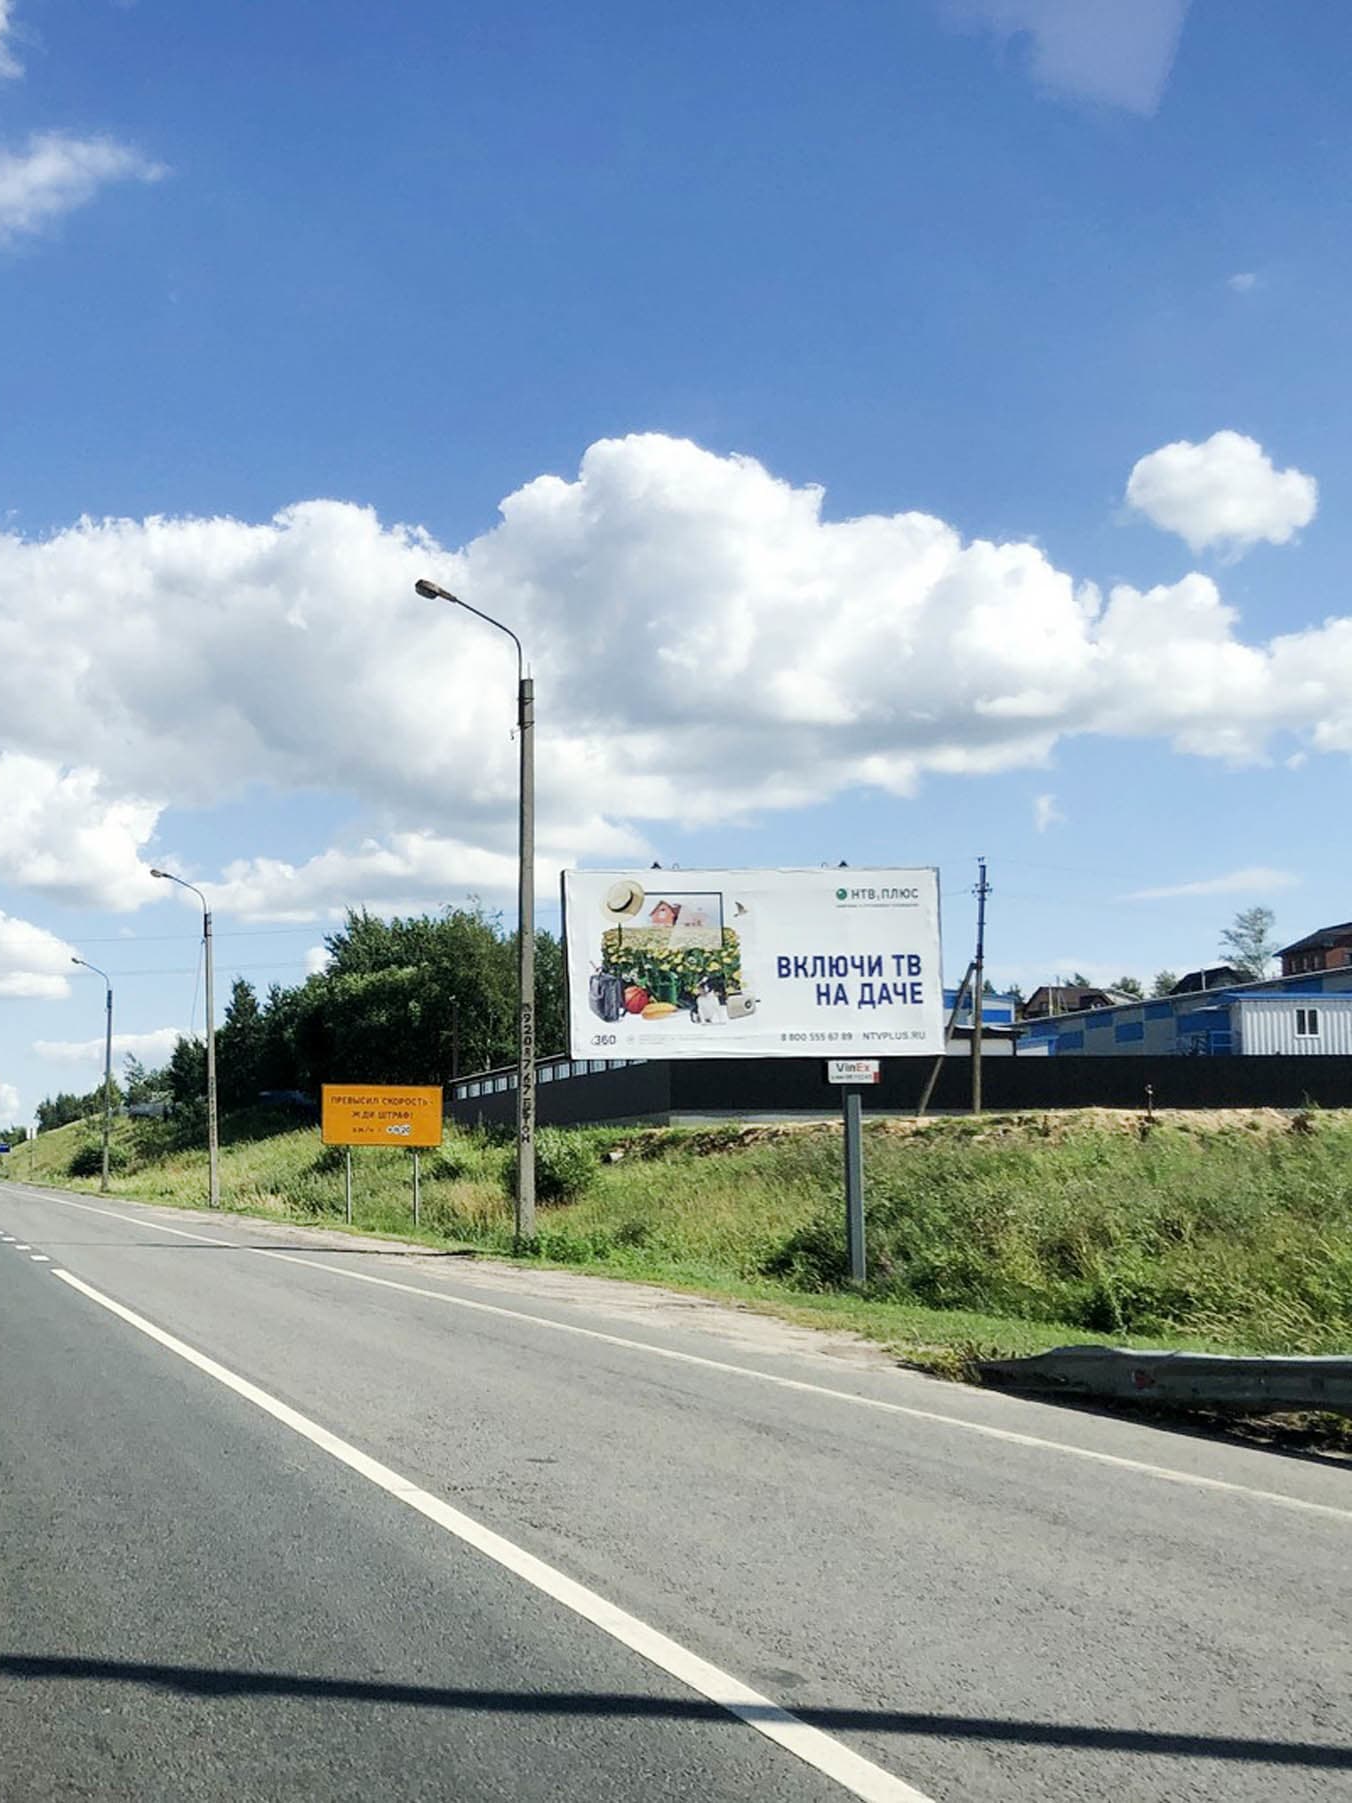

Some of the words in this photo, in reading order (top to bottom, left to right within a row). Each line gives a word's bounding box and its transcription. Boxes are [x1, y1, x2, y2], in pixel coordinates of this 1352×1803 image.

[777, 955, 883, 978] ВКЛЮЧИ
[891, 954, 922, 977] ТВ
[816, 983, 849, 1006] НА
[858, 982, 924, 1009] ДАЧЕ
[789, 1033, 807, 1042] 800
[809, 1032, 826, 1042] 555
[862, 1031, 927, 1041] NTVPLUS.RU
[330, 1096, 380, 1105] ПРЕВЫСИЛ
[382, 1097, 427, 1106] СКОРОСТЬ
[352, 1111, 374, 1120] ЖДИ
